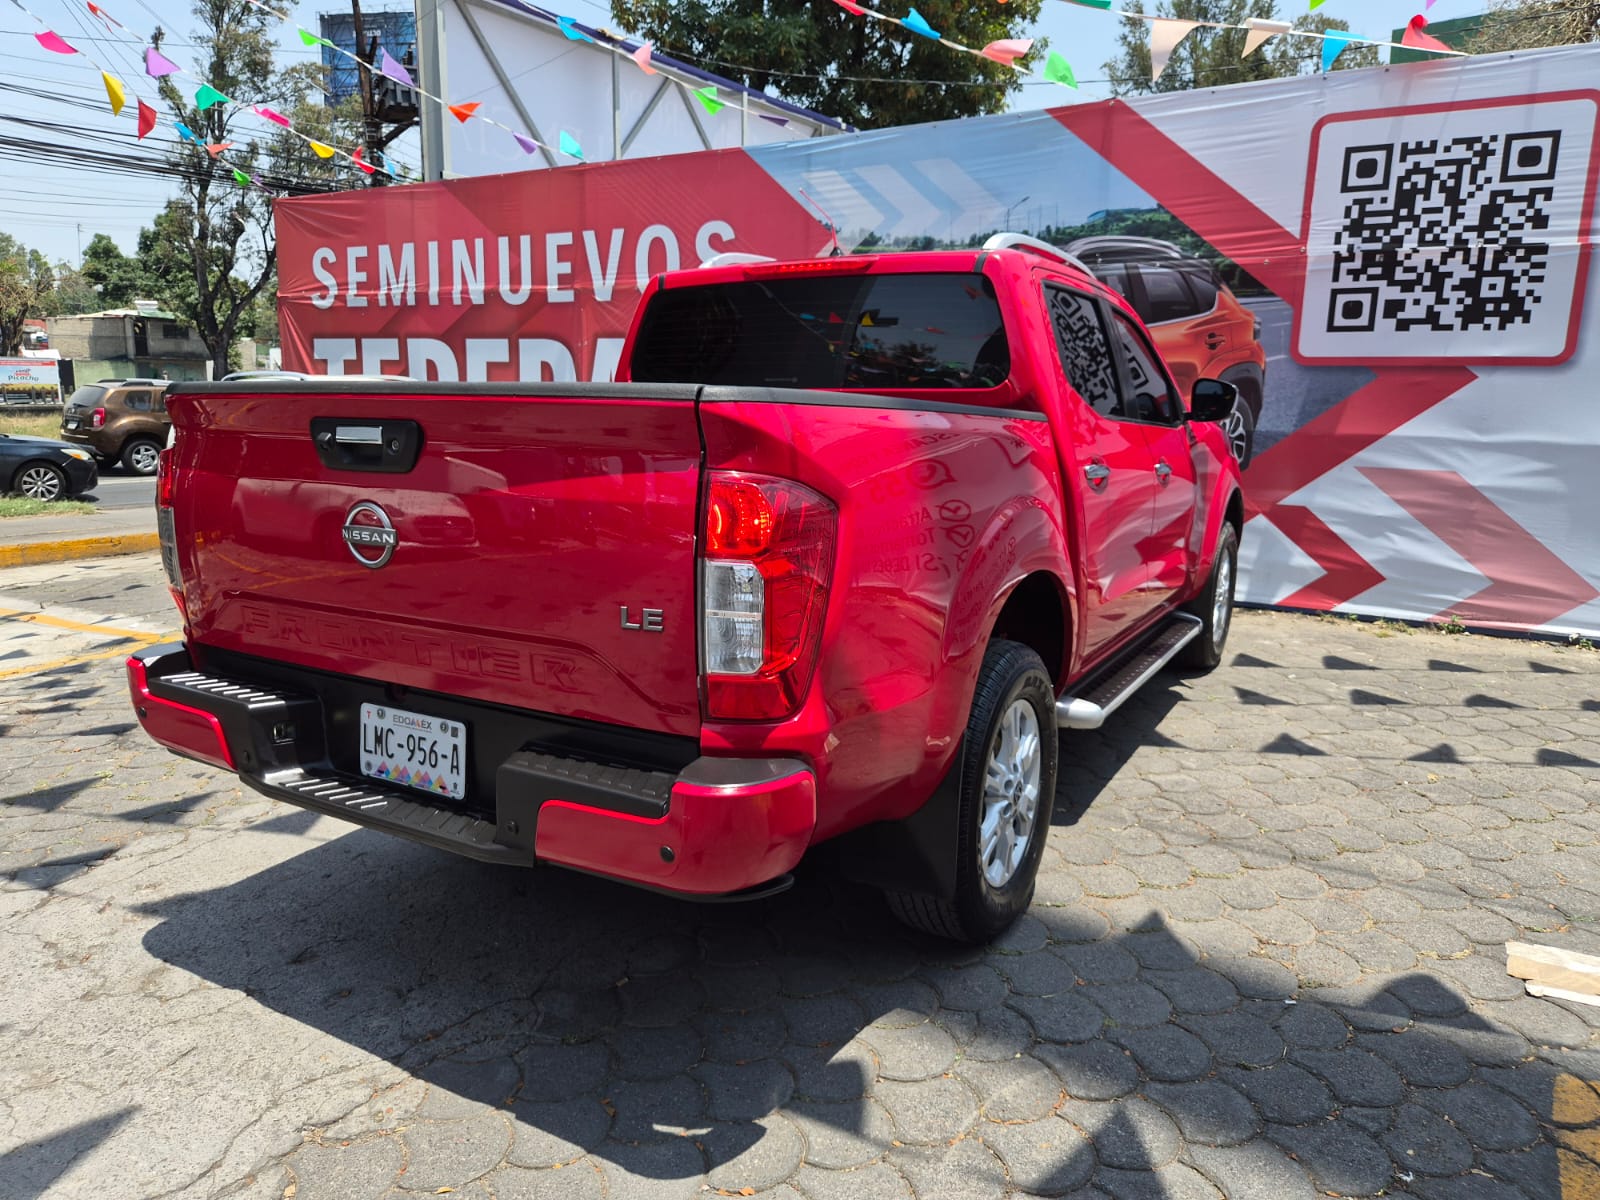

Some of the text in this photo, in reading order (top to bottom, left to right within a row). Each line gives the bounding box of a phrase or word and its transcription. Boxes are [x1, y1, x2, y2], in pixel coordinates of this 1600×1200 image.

[342, 529, 394, 543] NISSAN
[620, 605, 664, 633] LE
[240, 605, 579, 690] FRONTIER
[364, 723, 459, 776] LMC-956-A
